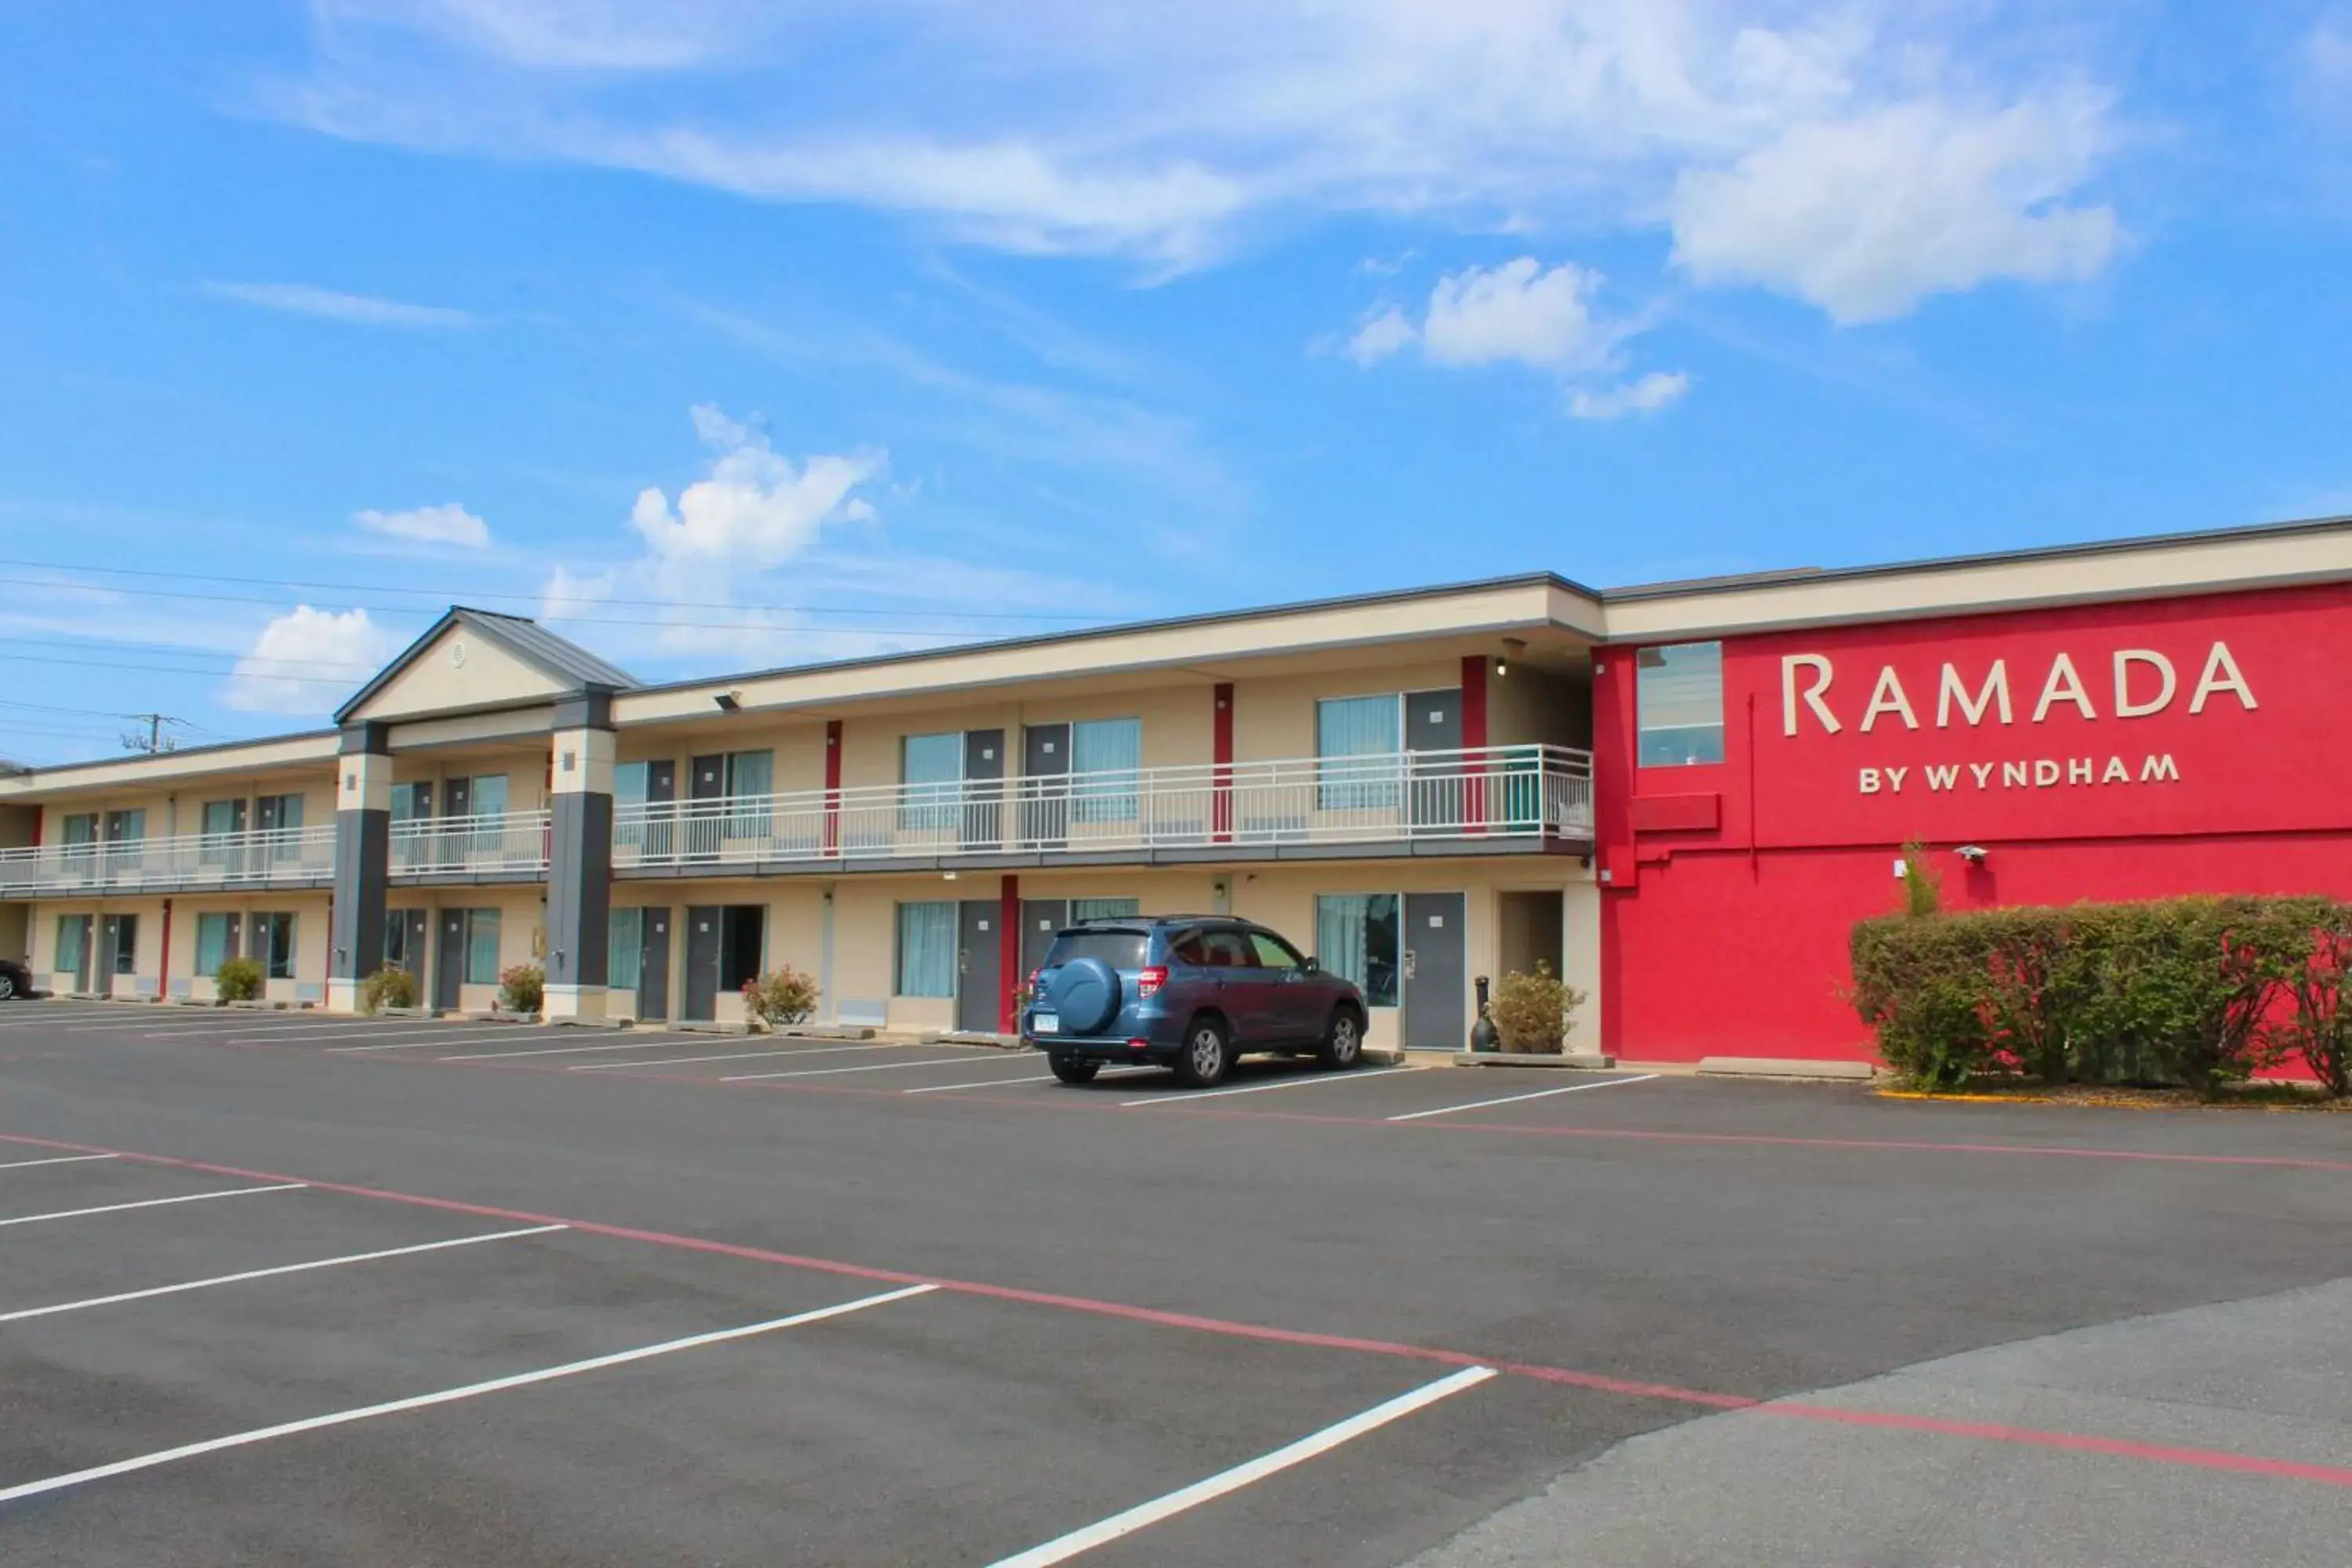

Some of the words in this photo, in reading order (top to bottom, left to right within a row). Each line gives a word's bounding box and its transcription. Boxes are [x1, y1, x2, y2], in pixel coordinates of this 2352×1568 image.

[1781, 641, 2259, 736] RAMADA
[1859, 767, 1908, 793] BY
[1925, 753, 2180, 791] WYNDHAM
